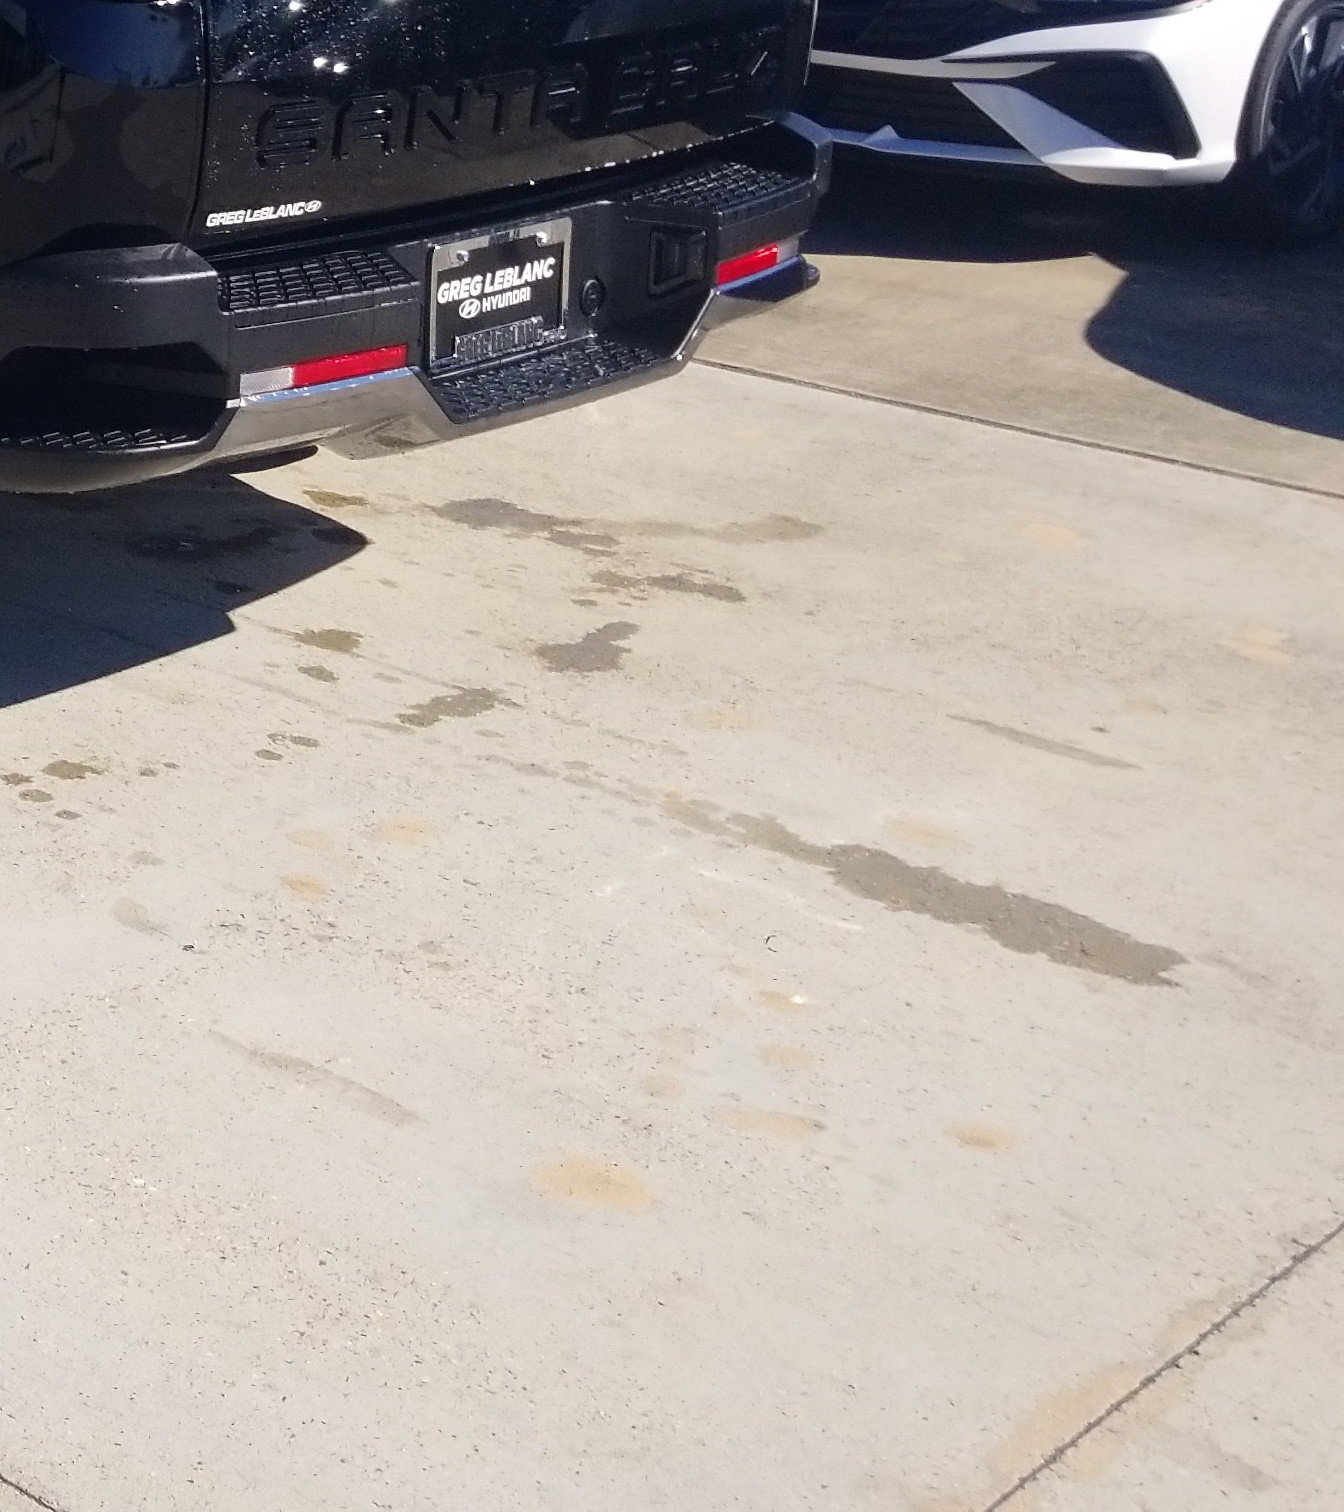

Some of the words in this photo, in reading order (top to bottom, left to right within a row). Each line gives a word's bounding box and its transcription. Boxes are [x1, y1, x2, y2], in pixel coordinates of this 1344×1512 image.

[256, 62, 586, 169] SANTA
[206, 210, 246, 227] GREG
[437, 275, 483, 304] GREG
[484, 257, 556, 294] LEBLANC
[482, 287, 531, 313] HYUNDAI
